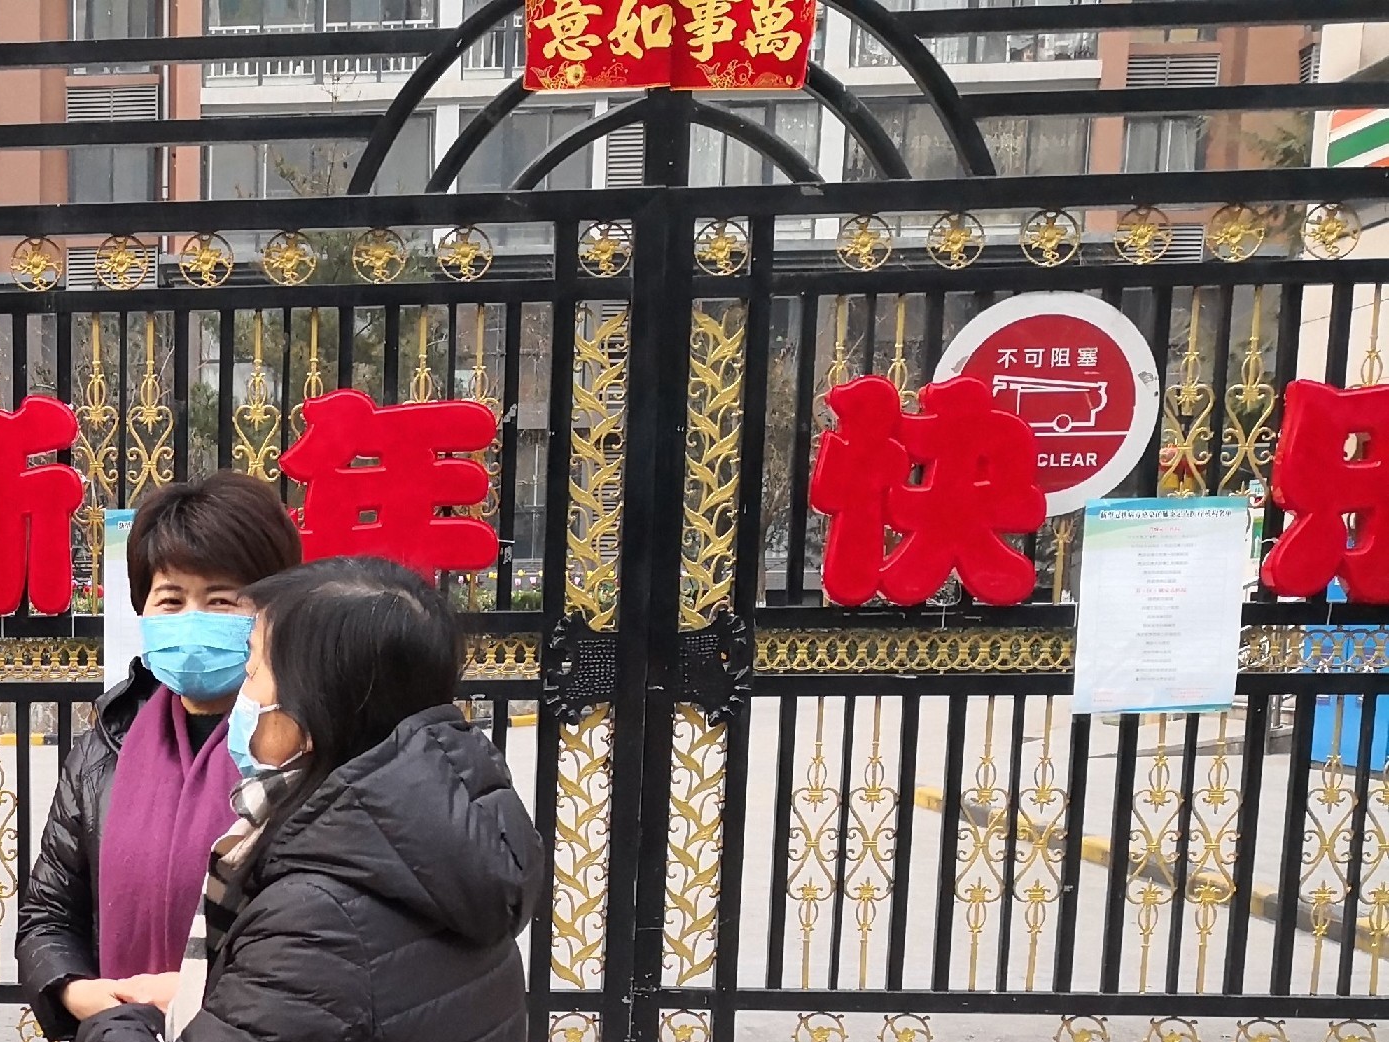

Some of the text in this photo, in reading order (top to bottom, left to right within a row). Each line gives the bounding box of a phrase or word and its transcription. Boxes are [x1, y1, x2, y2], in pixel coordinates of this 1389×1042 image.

[996, 346, 1099, 369] 不可阻塞
[1037, 452, 1098, 467] CLEAR
